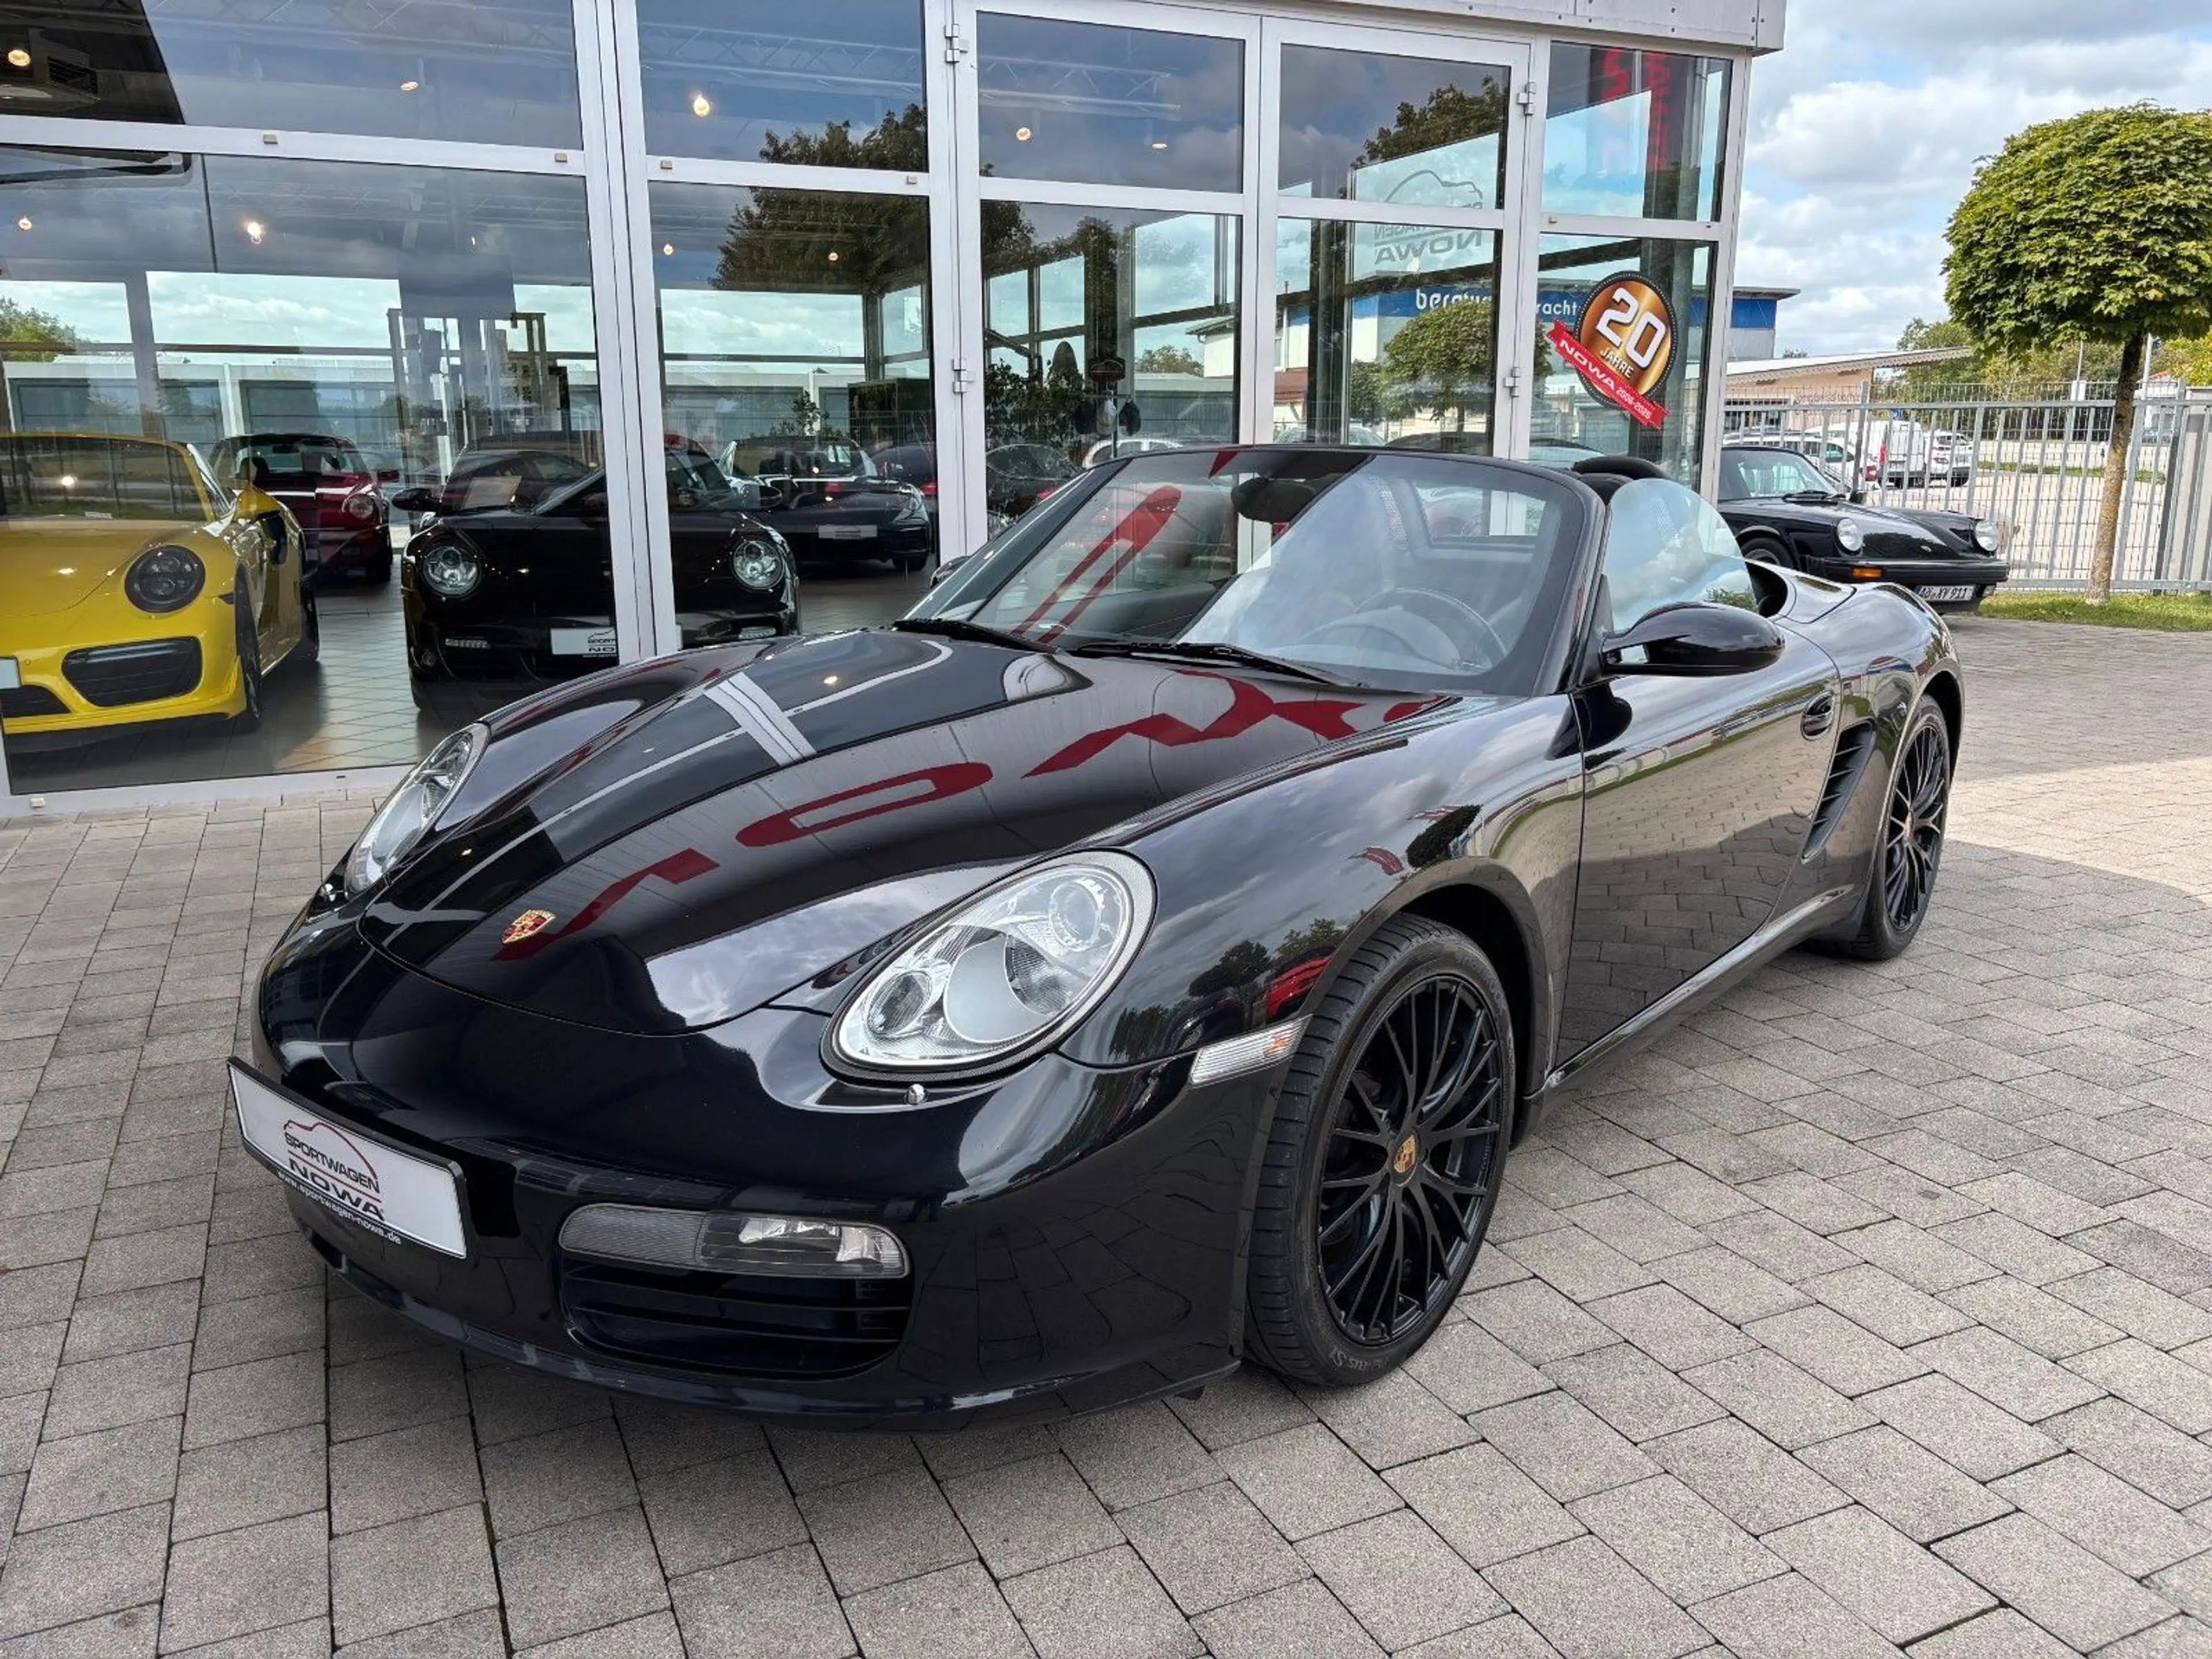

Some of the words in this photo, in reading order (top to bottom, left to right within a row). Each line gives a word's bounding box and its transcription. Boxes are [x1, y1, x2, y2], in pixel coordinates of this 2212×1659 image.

[1536, 300, 1578, 316] racht
[1595, 287, 1666, 369] 20
[1559, 340, 1615, 391] NOWA
[1599, 347, 1634, 378] JAHRE
[285, 1131, 380, 1194] SPORTWAGEN
[289, 1158, 385, 1221] NOWA
